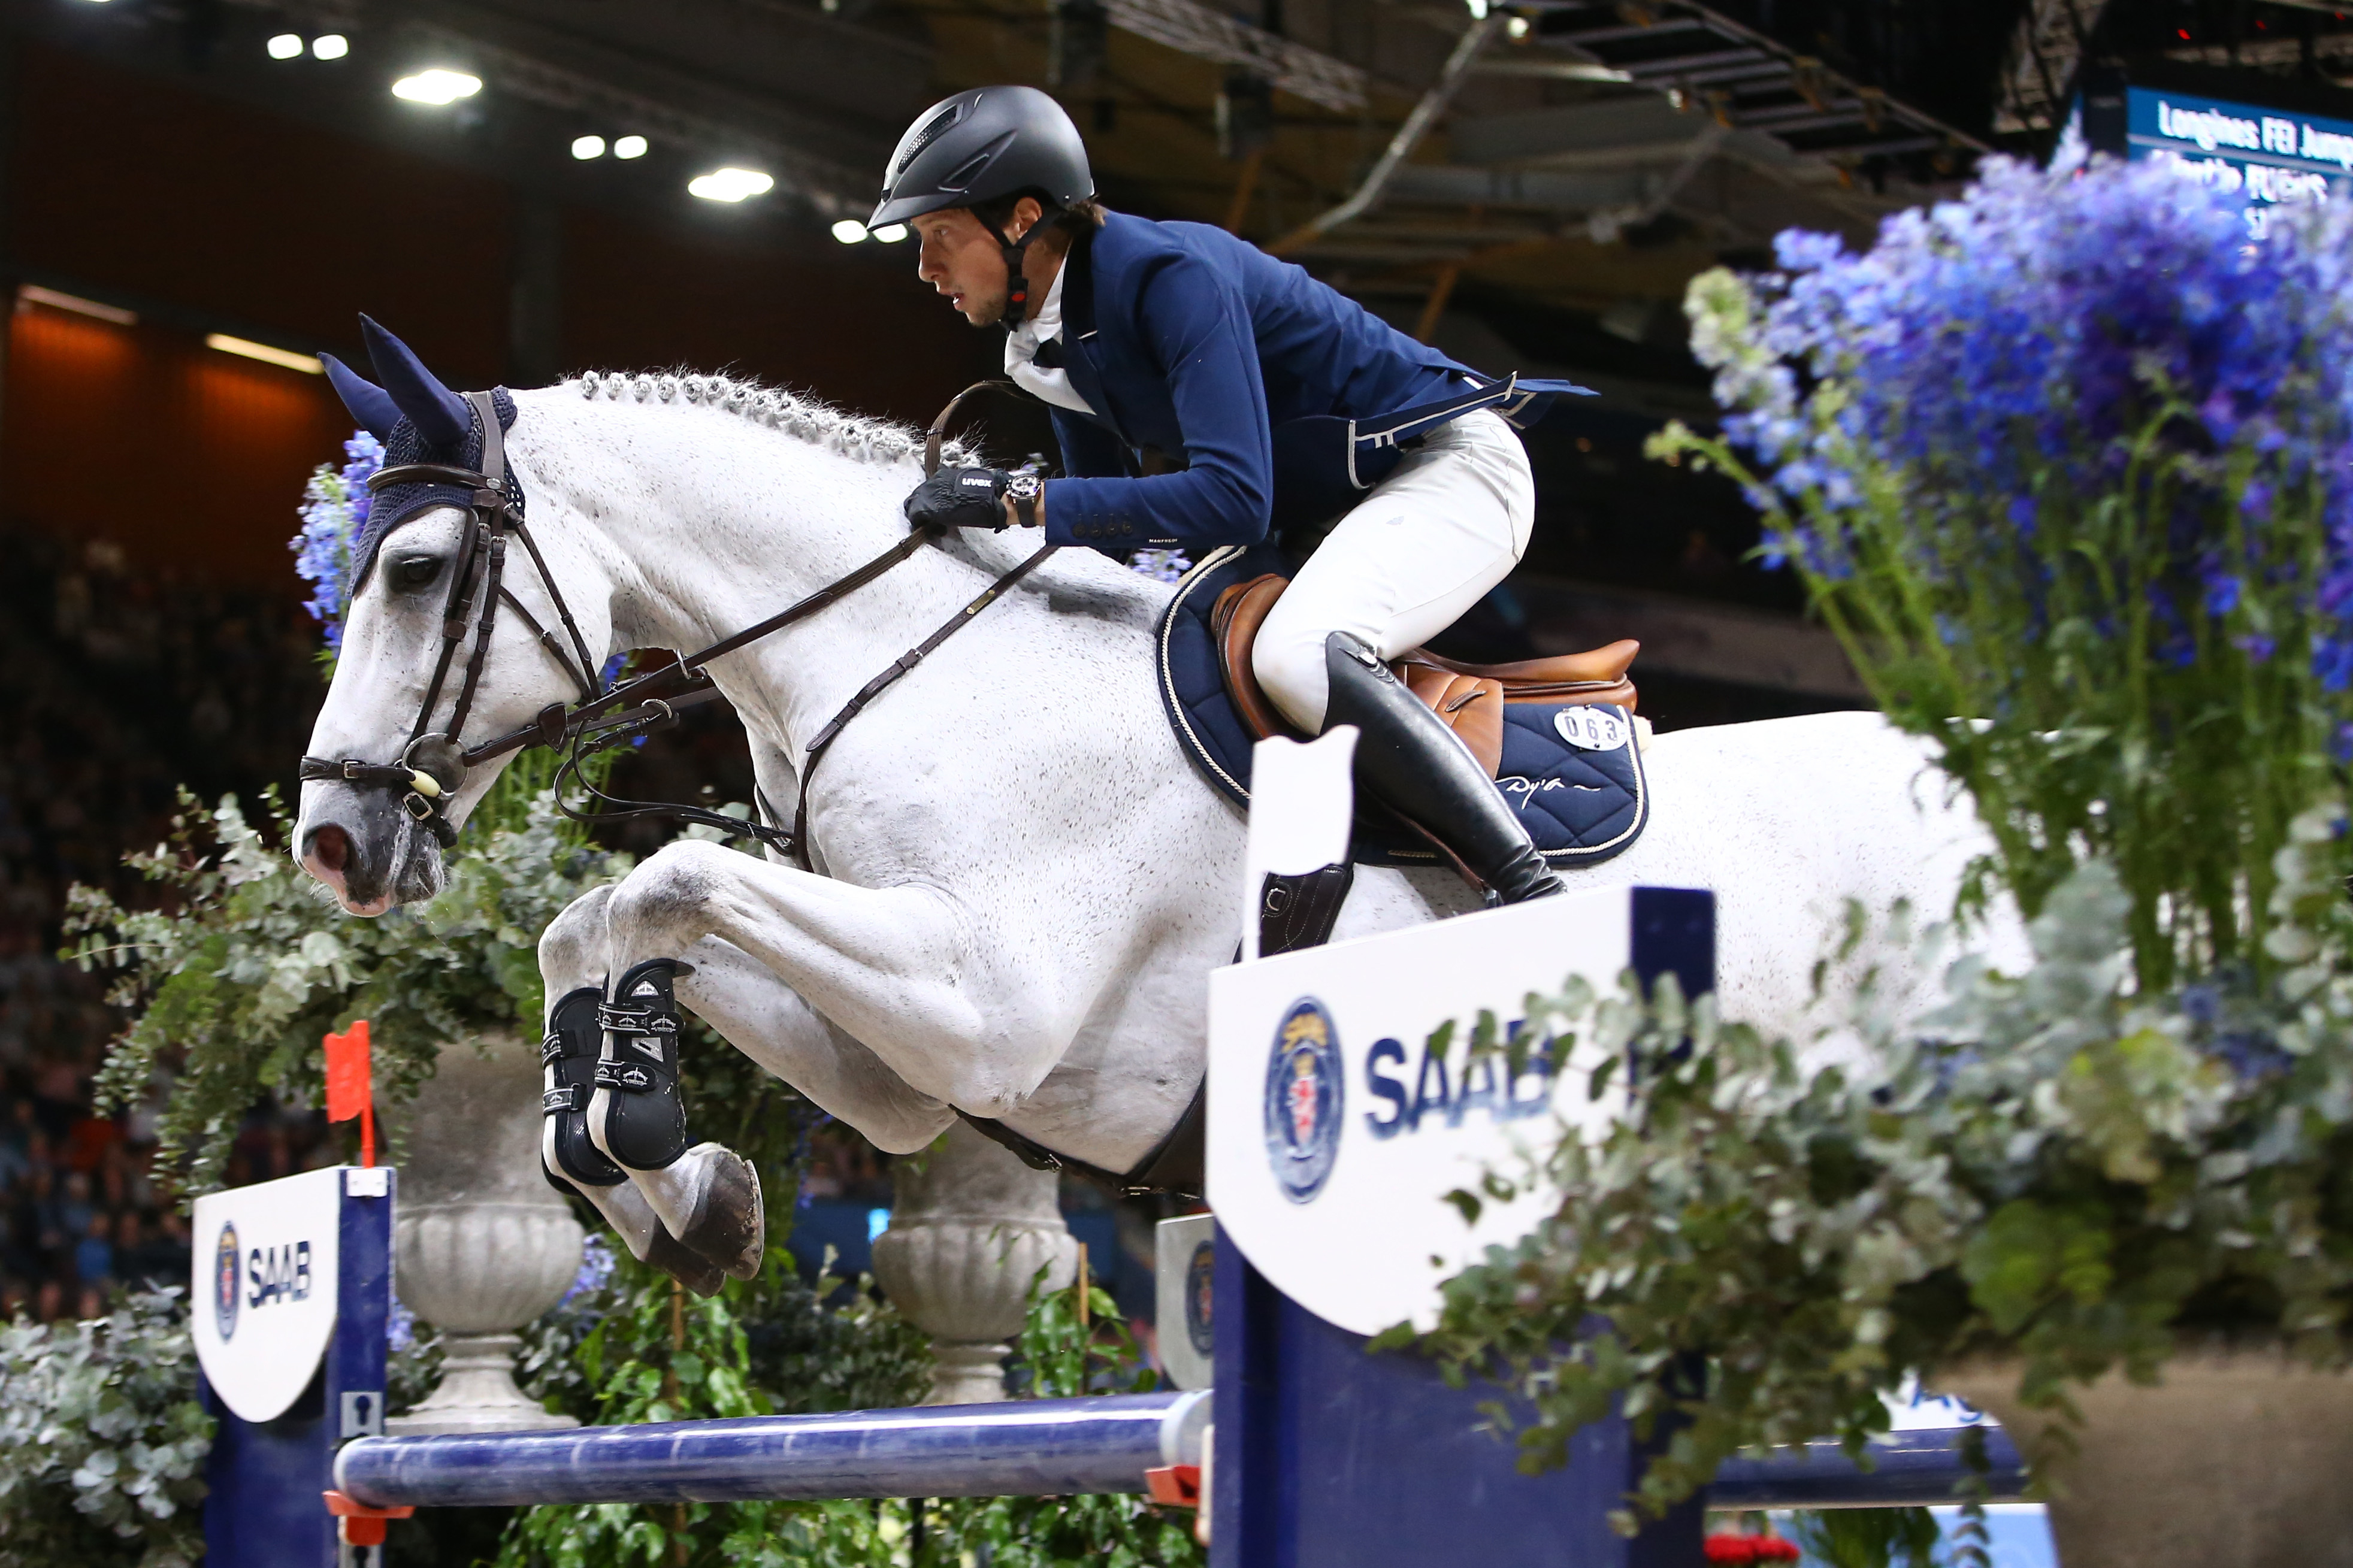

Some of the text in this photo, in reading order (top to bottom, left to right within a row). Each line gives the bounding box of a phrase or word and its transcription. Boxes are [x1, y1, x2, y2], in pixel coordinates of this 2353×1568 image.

[2158, 100, 2260, 152] Longines
[2261, 116, 2297, 155] FEI
[962, 477, 992, 488] uvex
[1564, 716, 1618, 741] 063
[1363, 1019, 1560, 1139] SAAB
[247, 1240, 311, 1309] SAAB
